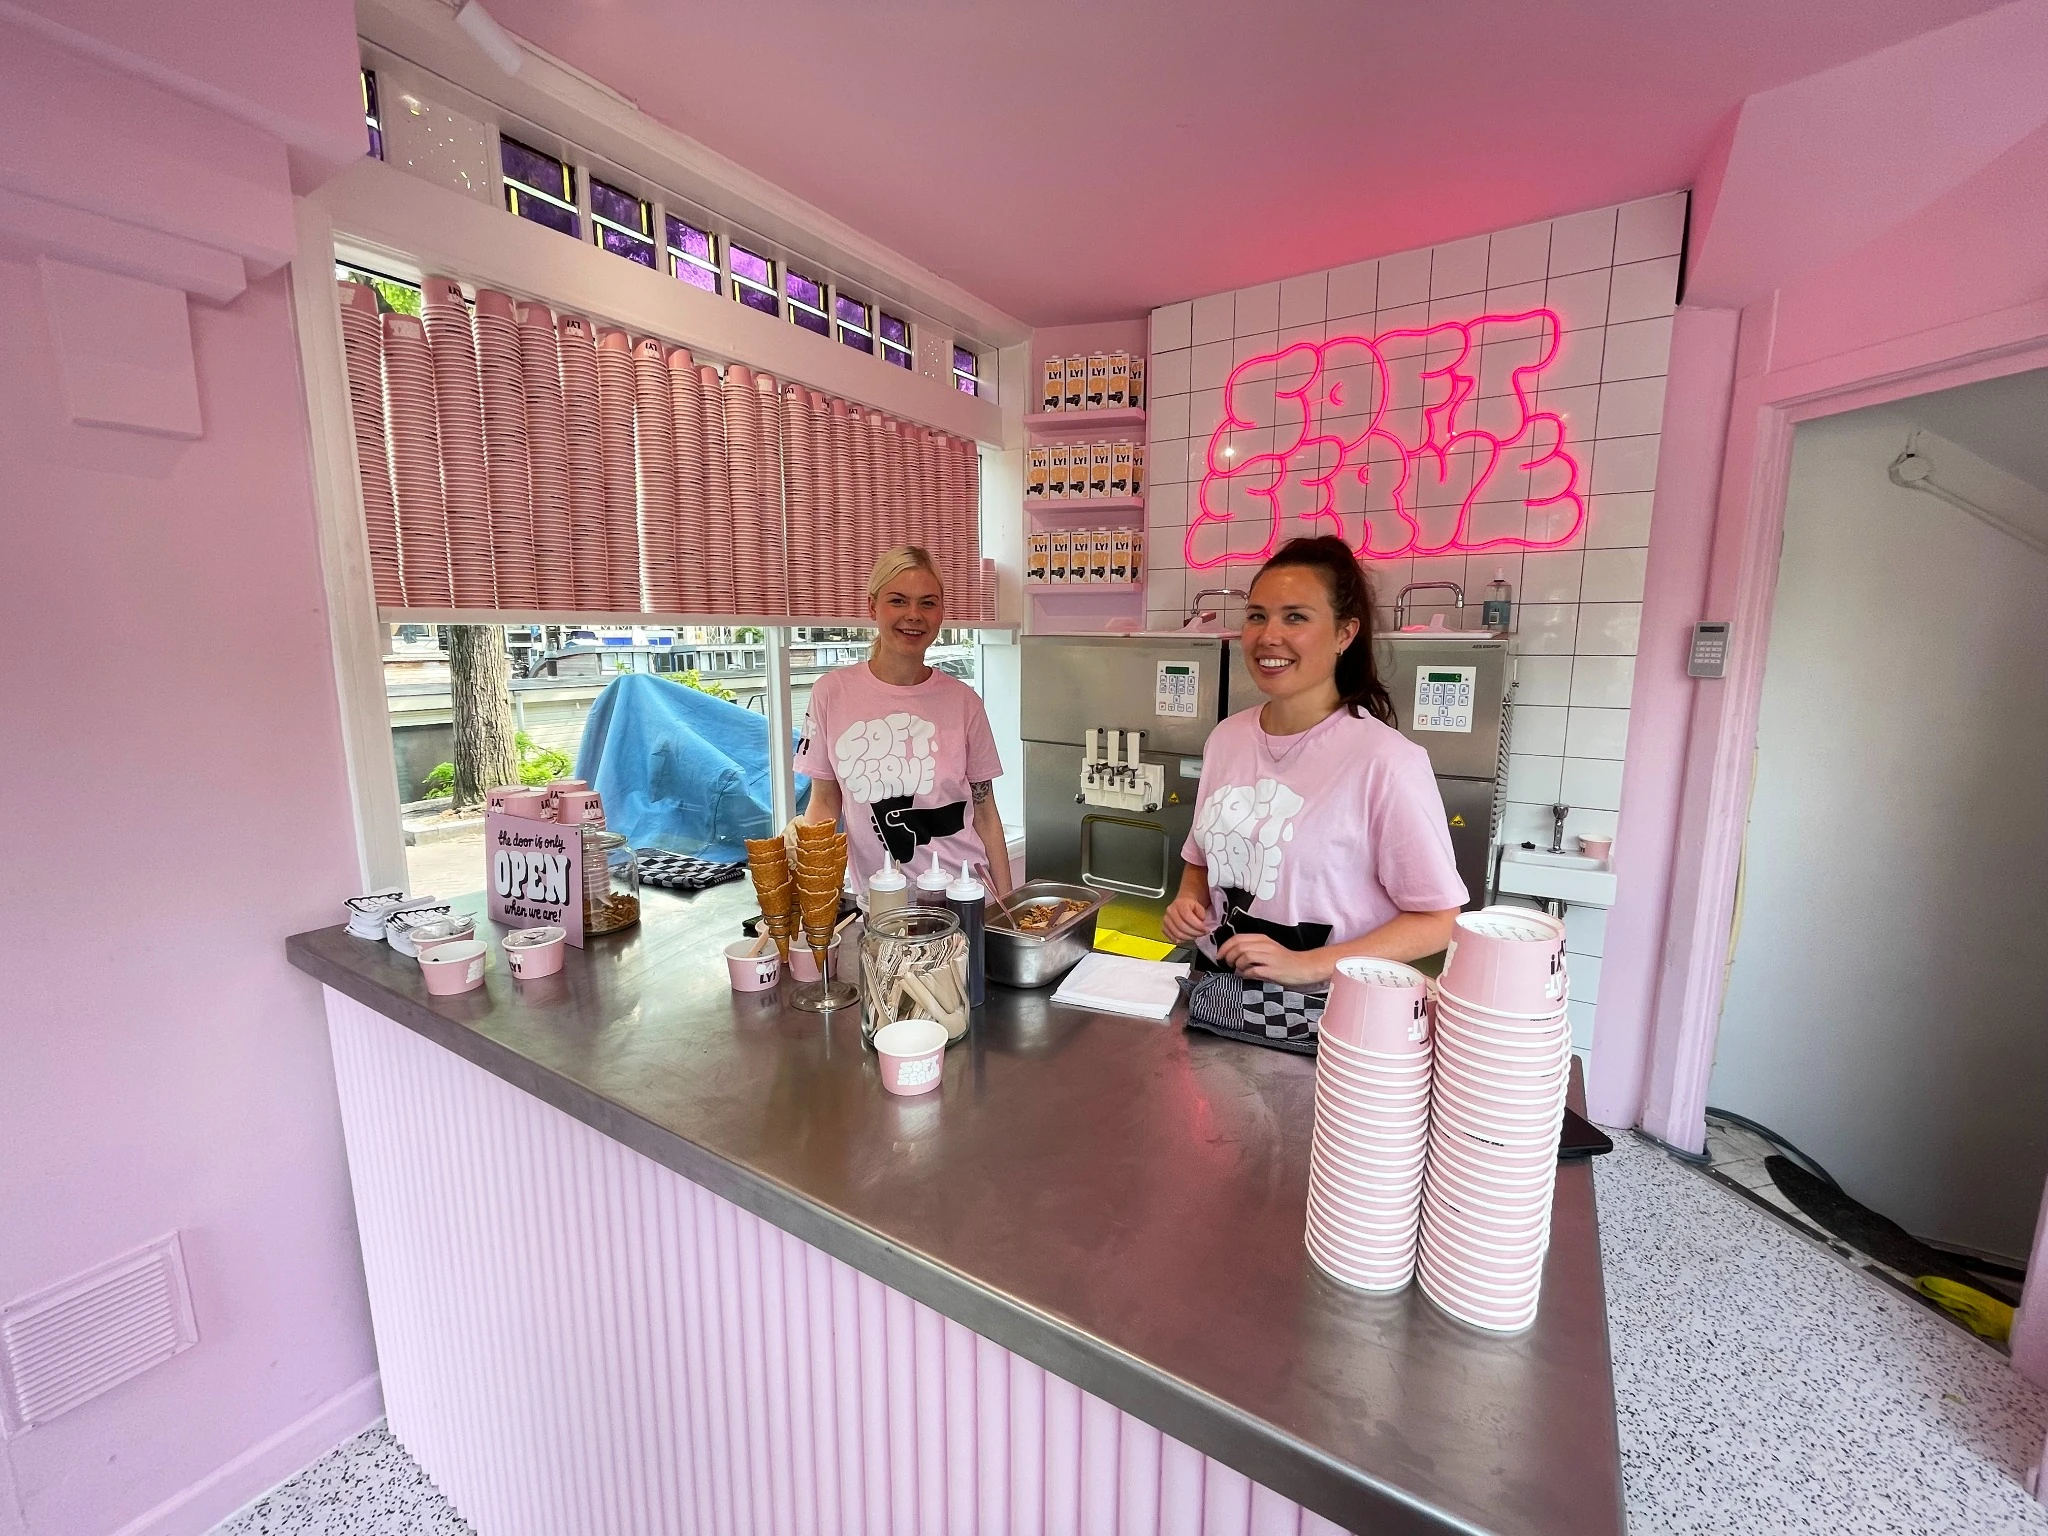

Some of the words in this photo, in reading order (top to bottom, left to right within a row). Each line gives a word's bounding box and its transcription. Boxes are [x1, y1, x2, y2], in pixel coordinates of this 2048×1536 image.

[1070, 369, 1083, 377] LY!
[1092, 368, 1105, 376] LY!
[1113, 366, 1126, 374] LY!
[1048, 371, 1062, 380] LY!
[1209, 308, 1562, 476] SOFT
[1033, 459, 1046, 467] LY!
[1054, 458, 1066, 466] LY!
[1074, 457, 1087, 465] LY!
[1095, 456, 1108, 464] LY!
[1116, 454, 1130, 463] LY!
[1185, 413, 1585, 570] SERVE
[1035, 544, 1047, 552] LY!
[1055, 544, 1067, 552] LY!
[1095, 543, 1108, 551] LY!
[1116, 542, 1129, 550] LY!
[835, 712, 936, 780] SOFT
[845, 756, 936, 804] SERVE
[1194, 778, 1304, 849] SOFT
[498, 830, 511, 846] the
[513, 832, 533, 847] door
[534, 834, 542, 849] is
[544, 834, 566, 853] only
[1204, 831, 1283, 901] SERVE
[494, 849, 571, 906] OPEN
[504, 899, 527, 917] when
[528, 907, 541, 919] we
[542, 908, 562, 923] are!
[760, 970, 777, 984] LY!
[899, 1054, 939, 1074] SOFT
